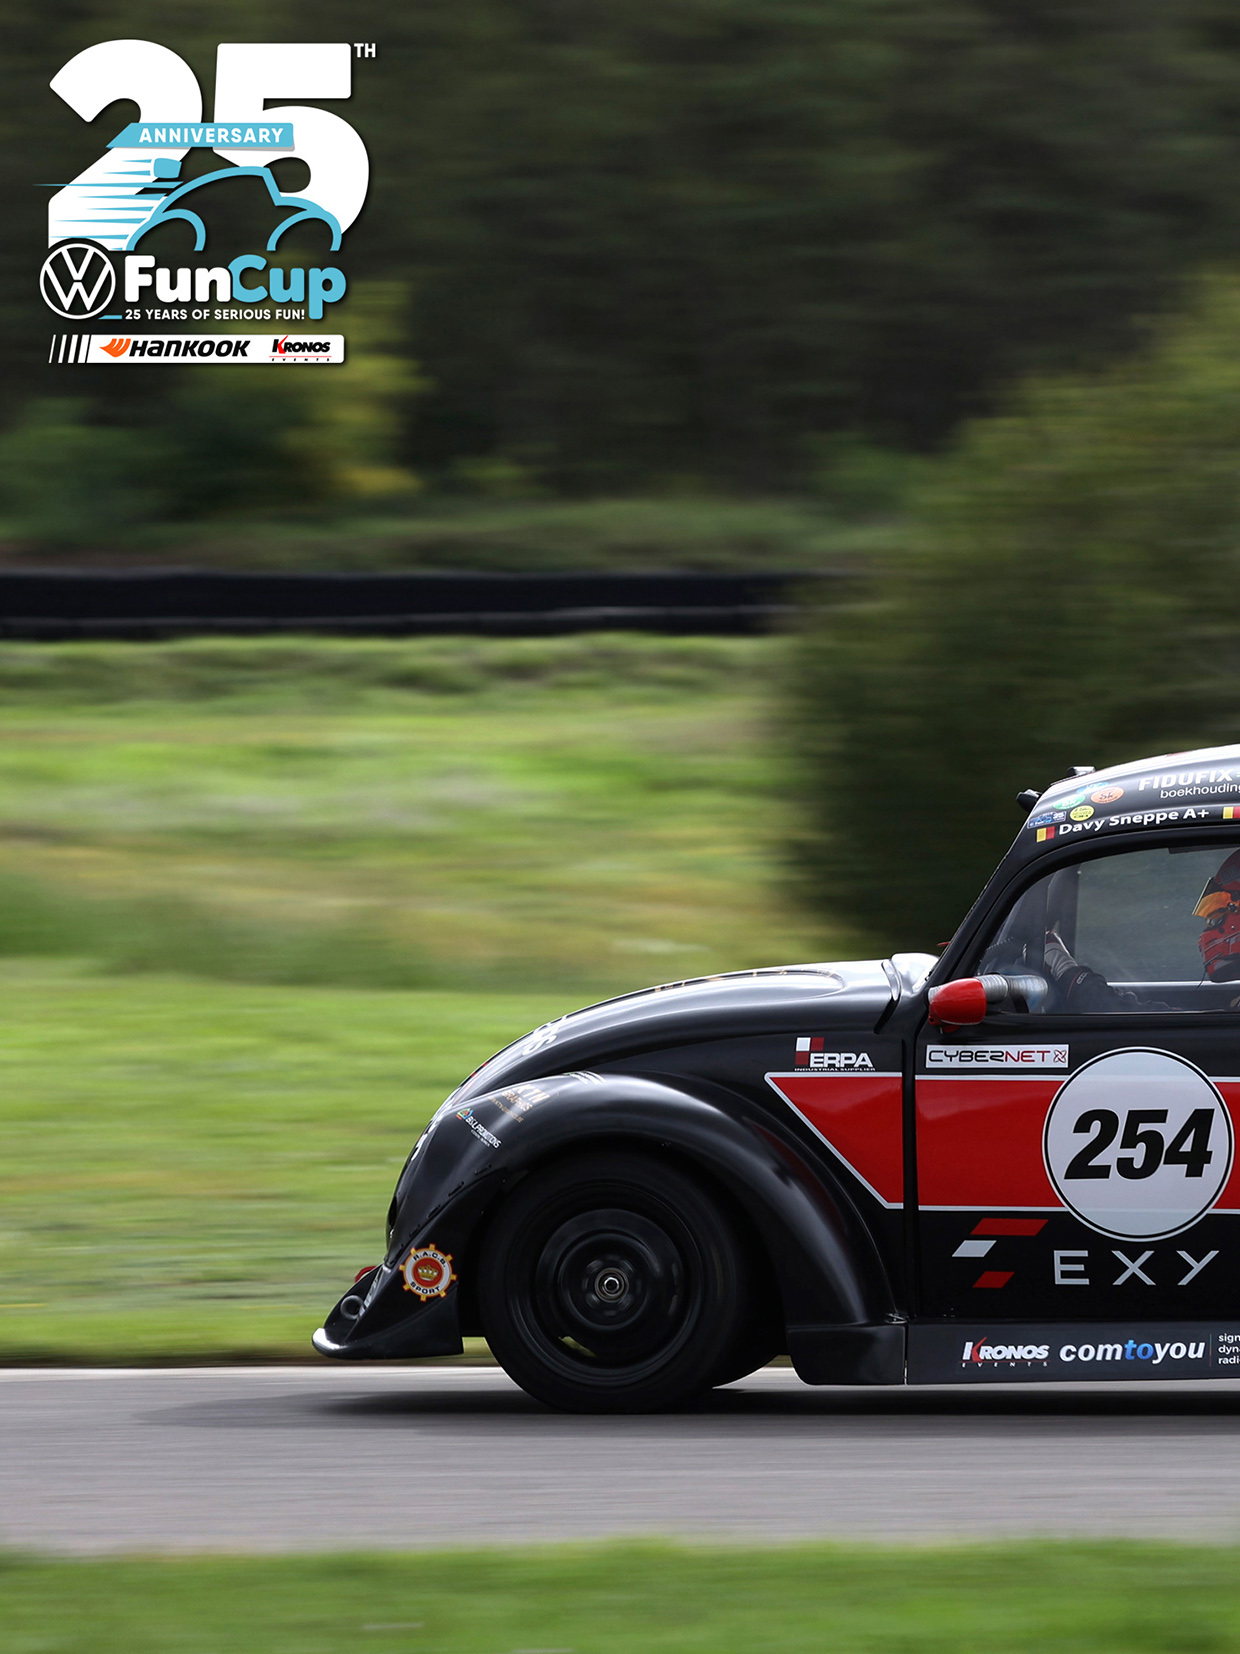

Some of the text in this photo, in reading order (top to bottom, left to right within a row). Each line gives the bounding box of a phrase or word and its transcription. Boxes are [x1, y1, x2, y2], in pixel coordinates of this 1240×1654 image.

[1138, 768, 1234, 791] FIDUFIX
[1059, 820, 1105, 835] Davy
[1109, 808, 1180, 827] Sneppe
[1183, 808, 1209, 820] A+
[810, 1053, 873, 1068] ERPA
[928, 1050, 1051, 1063] CYBERNET
[1063, 1108, 1216, 1180] 254
[410, 1281, 440, 1294] SPORT
[962, 1336, 1050, 1363] KRONOS
[1059, 1339, 1206, 1364] comtoyou
